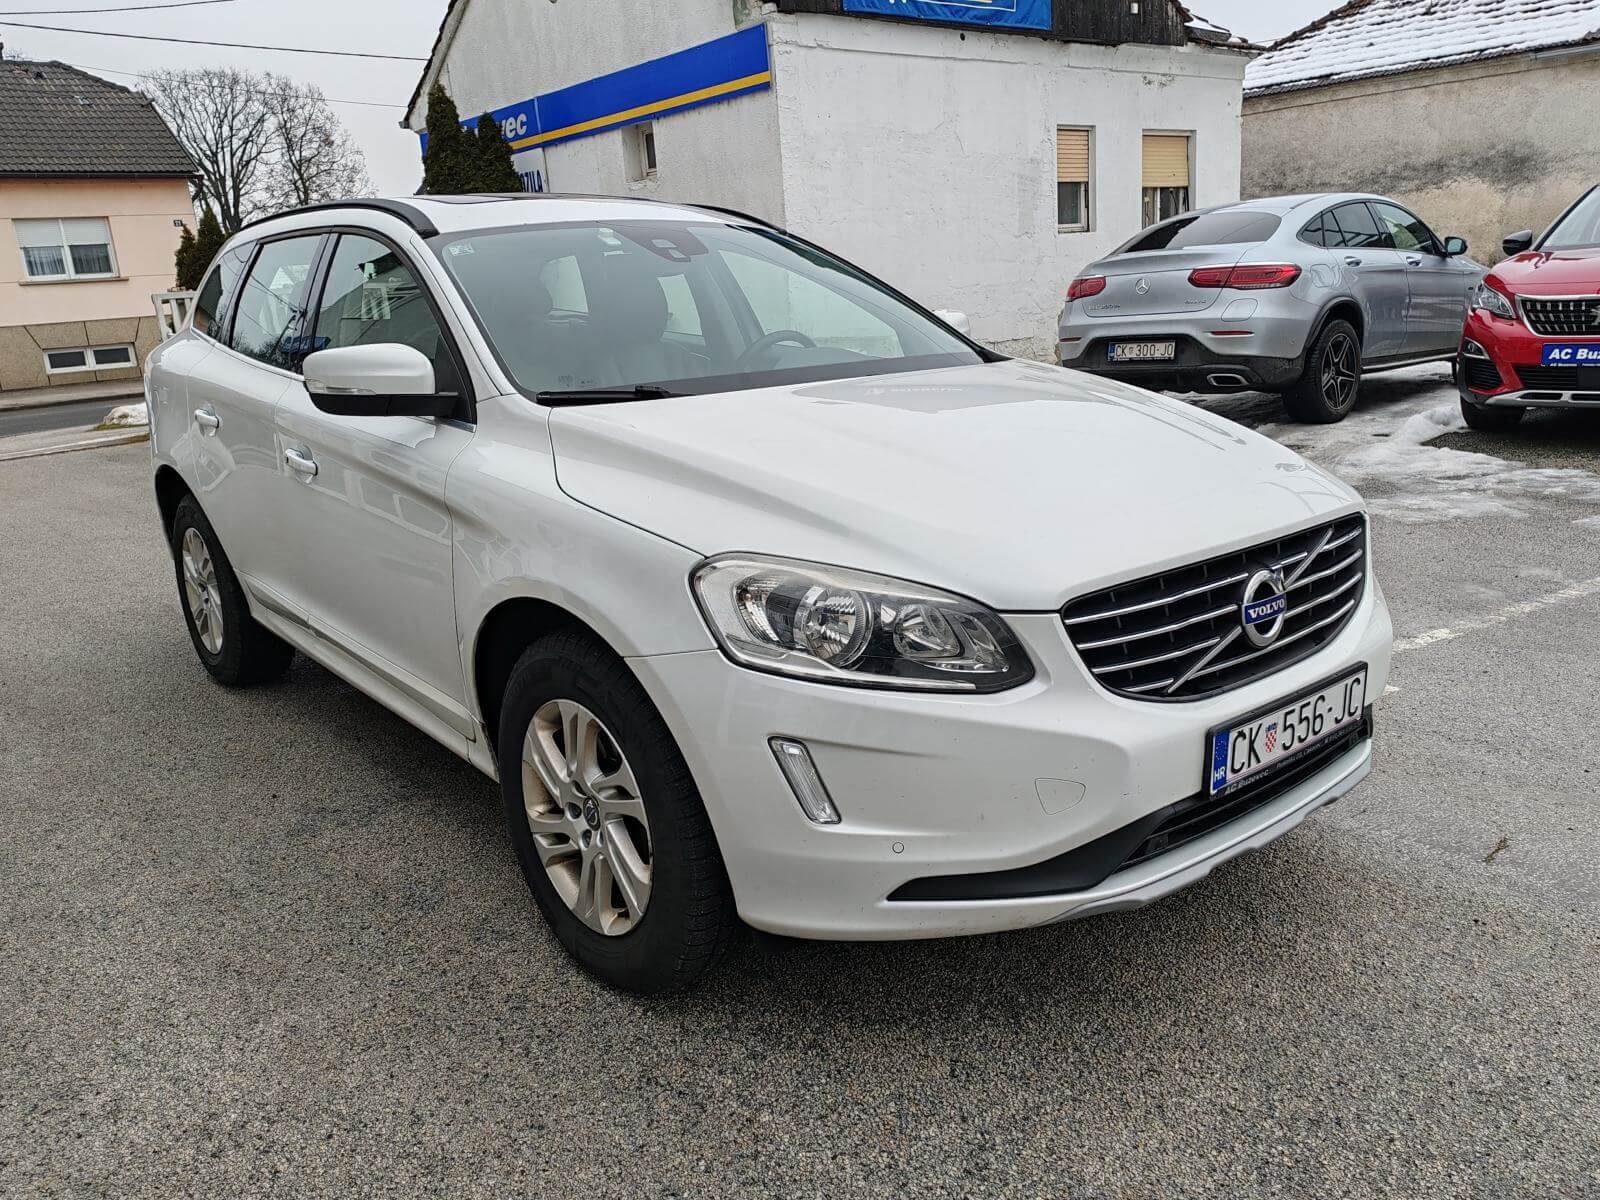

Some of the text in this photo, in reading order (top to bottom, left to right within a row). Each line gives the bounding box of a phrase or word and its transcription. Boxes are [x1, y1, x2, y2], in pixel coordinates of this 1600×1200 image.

[1548, 348, 1573, 360] AC
[1247, 598, 1285, 619] VOLVO
[1281, 677, 1361, 751] 556-JC
[1213, 766, 1226, 783] HR
